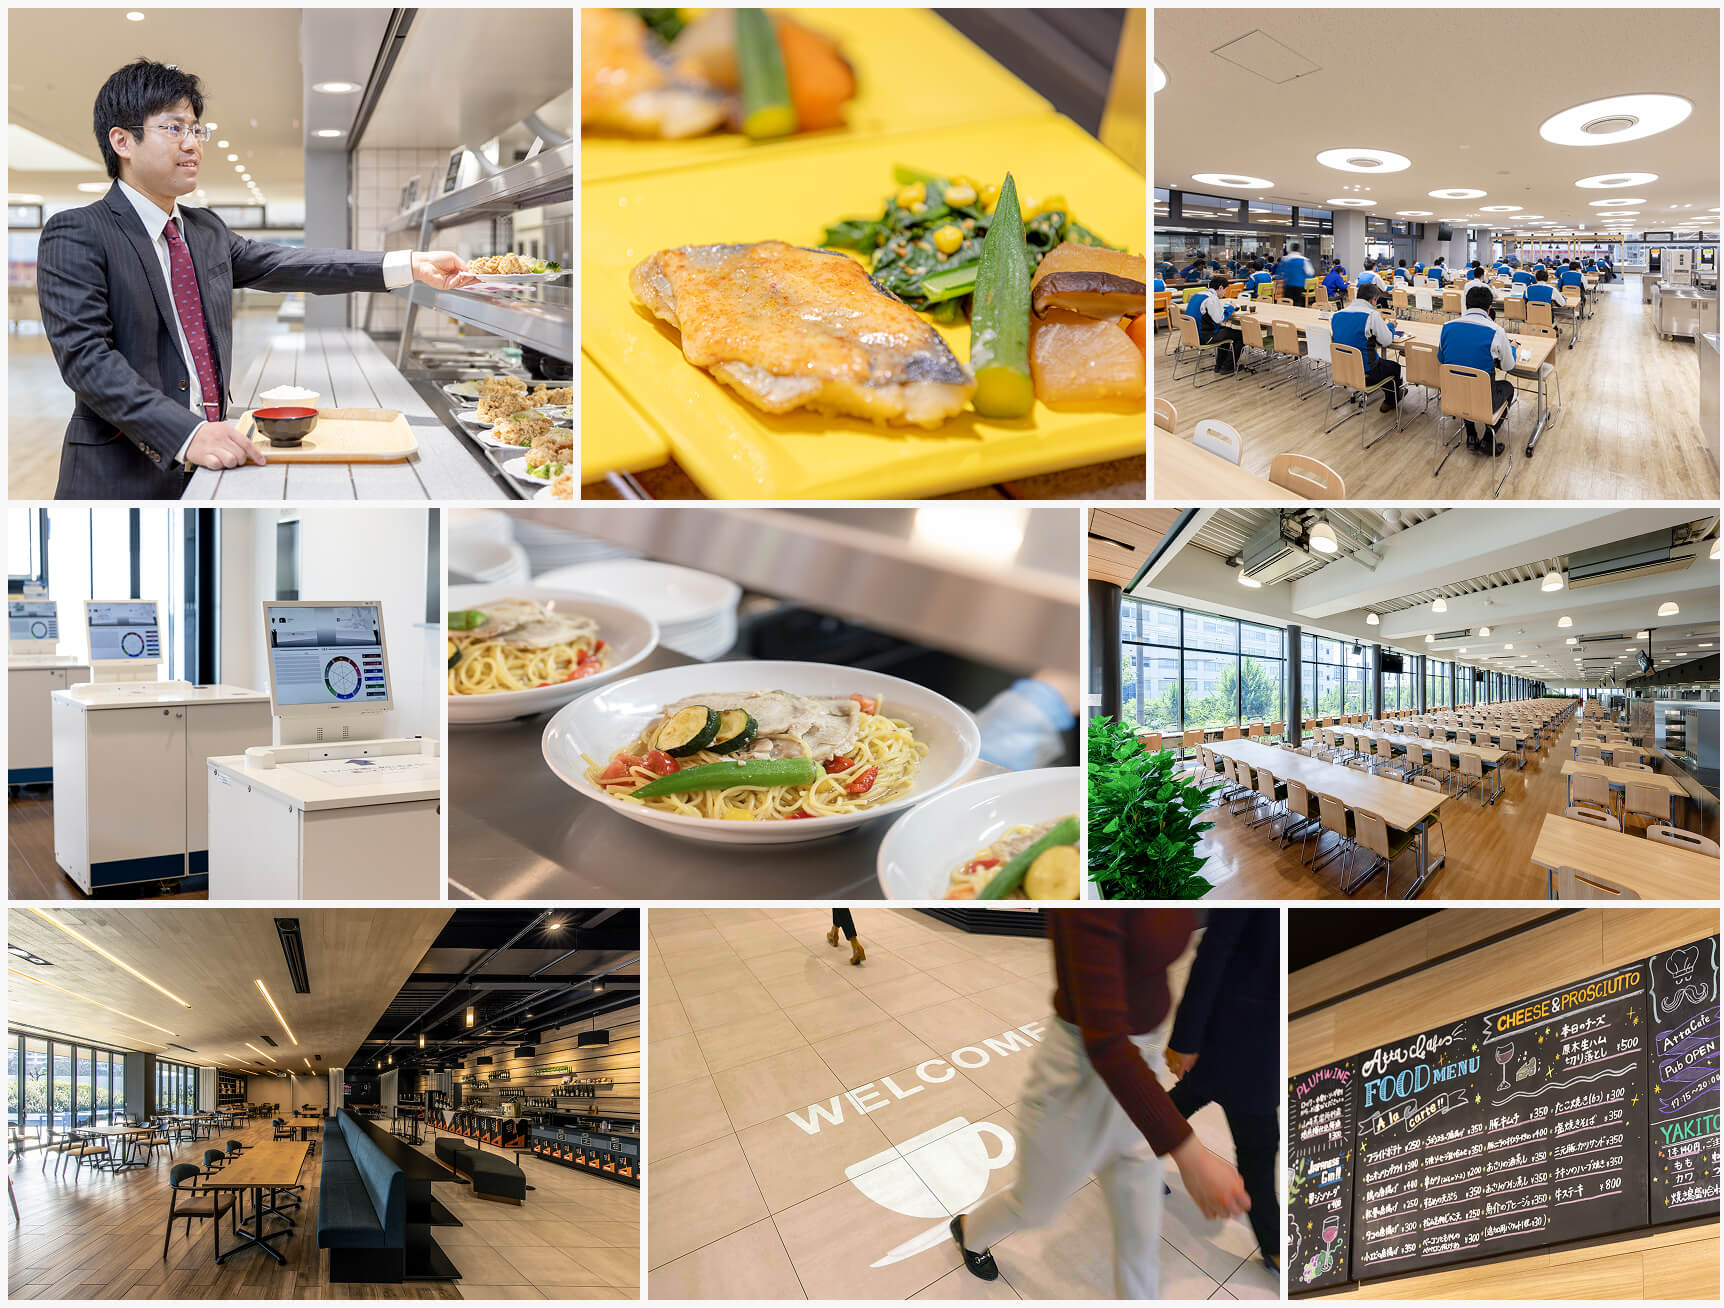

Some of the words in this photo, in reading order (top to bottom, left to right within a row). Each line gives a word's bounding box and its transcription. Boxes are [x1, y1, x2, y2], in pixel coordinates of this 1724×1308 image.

[1561, 1014, 1606, 1037] 本日のチーズ
[1562, 1036, 1607, 1055] 原木生ハム
[1565, 1048, 1607, 1065] 切り落とし
[1617, 1037, 1638, 1050] ¥500
[1665, 1061, 1683, 1078] Pub
[1685, 1041, 1715, 1064] OPEN
[1364, 1064, 1431, 1108] FOOD
[1433, 1056, 1480, 1084] MENU
[1606, 1088, 1625, 1102] ¥300
[1377, 1117, 1386, 1131] A
[1389, 1112, 1399, 1123] la
[1489, 1112, 1520, 1130] 豚キムチ
[1530, 1106, 1548, 1119] ¥350
[1554, 1114, 1597, 1134] 塩焼きそば
[1604, 1110, 1623, 1122] ¥350
[1606, 1134, 1623, 1145] ¥350
[1532, 1152, 1547, 1162] ¥350
[1606, 1156, 1623, 1167] ¥350
[1674, 1158, 1692, 1170] もも
[1531, 1172, 1547, 1184] ¥350
[1676, 1172, 1693, 1183] カワ
[1555, 1184, 1583, 1201] 牛ステーキ
[1600, 1177, 1621, 1191] ¥800
[1531, 1194, 1547, 1205] ¥350
